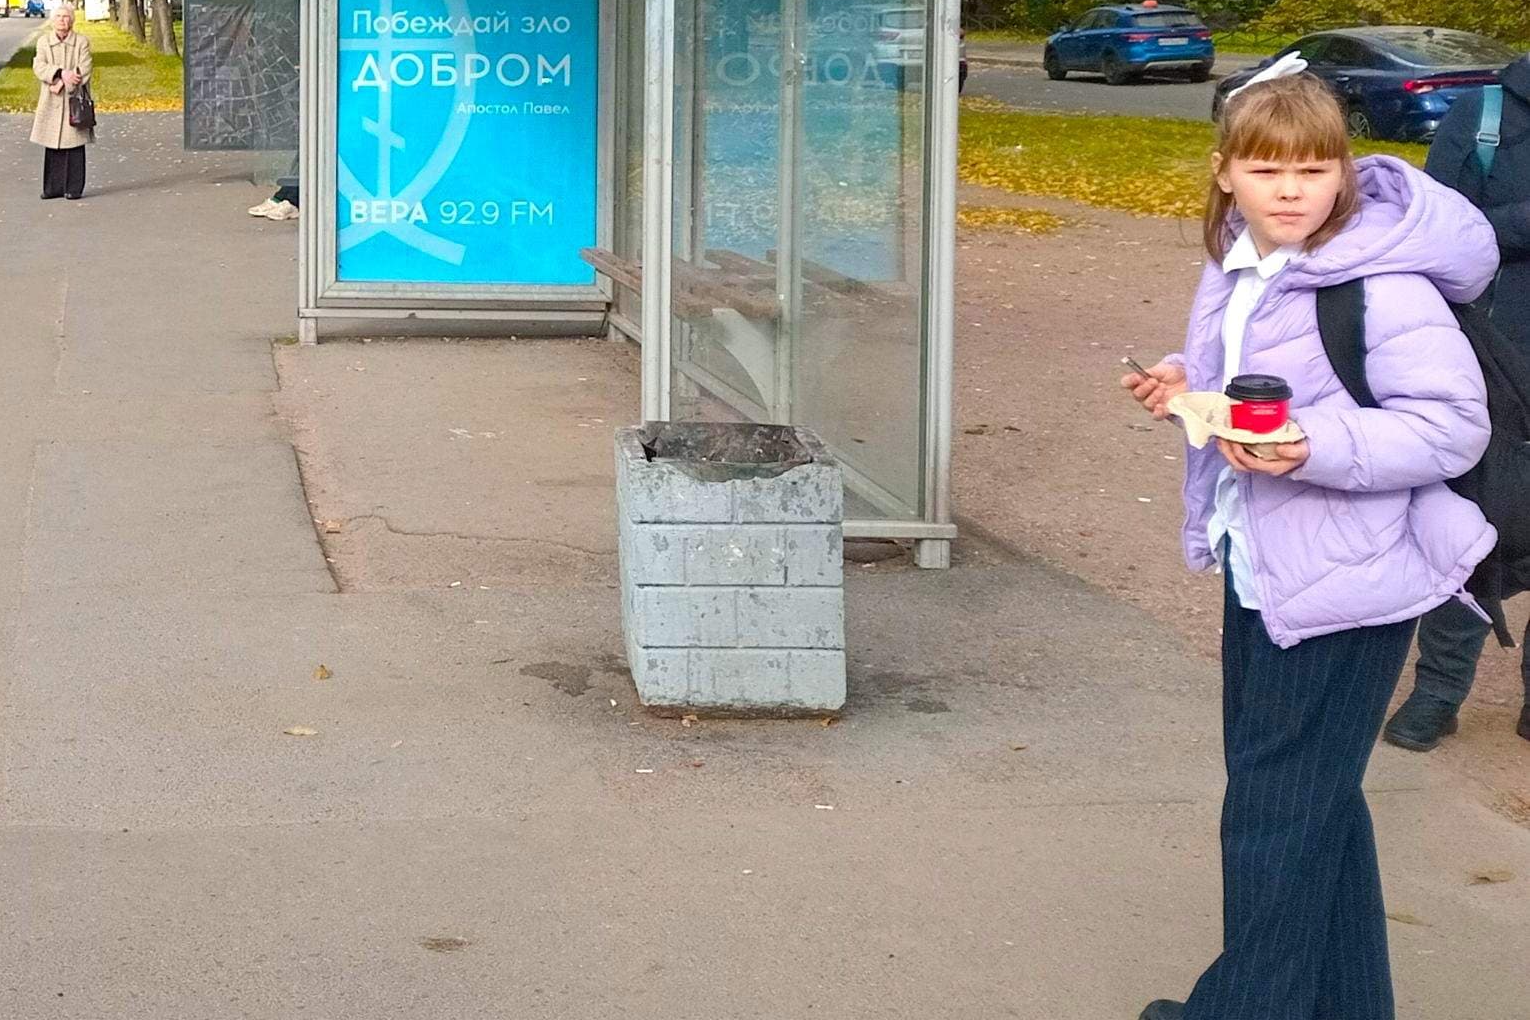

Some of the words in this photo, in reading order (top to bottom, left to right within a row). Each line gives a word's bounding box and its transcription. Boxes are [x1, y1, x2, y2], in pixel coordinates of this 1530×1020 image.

[352, 9, 510, 37] Побеждай
[520, 15, 571, 34] зло
[351, 52, 571, 92] ДОБРОМ
[456, 101, 519, 115] Апостол
[523, 101, 570, 115] Павел
[350, 200, 429, 224] ВЕРА
[439, 200, 501, 225] 92.9
[511, 200, 554, 225] FM
